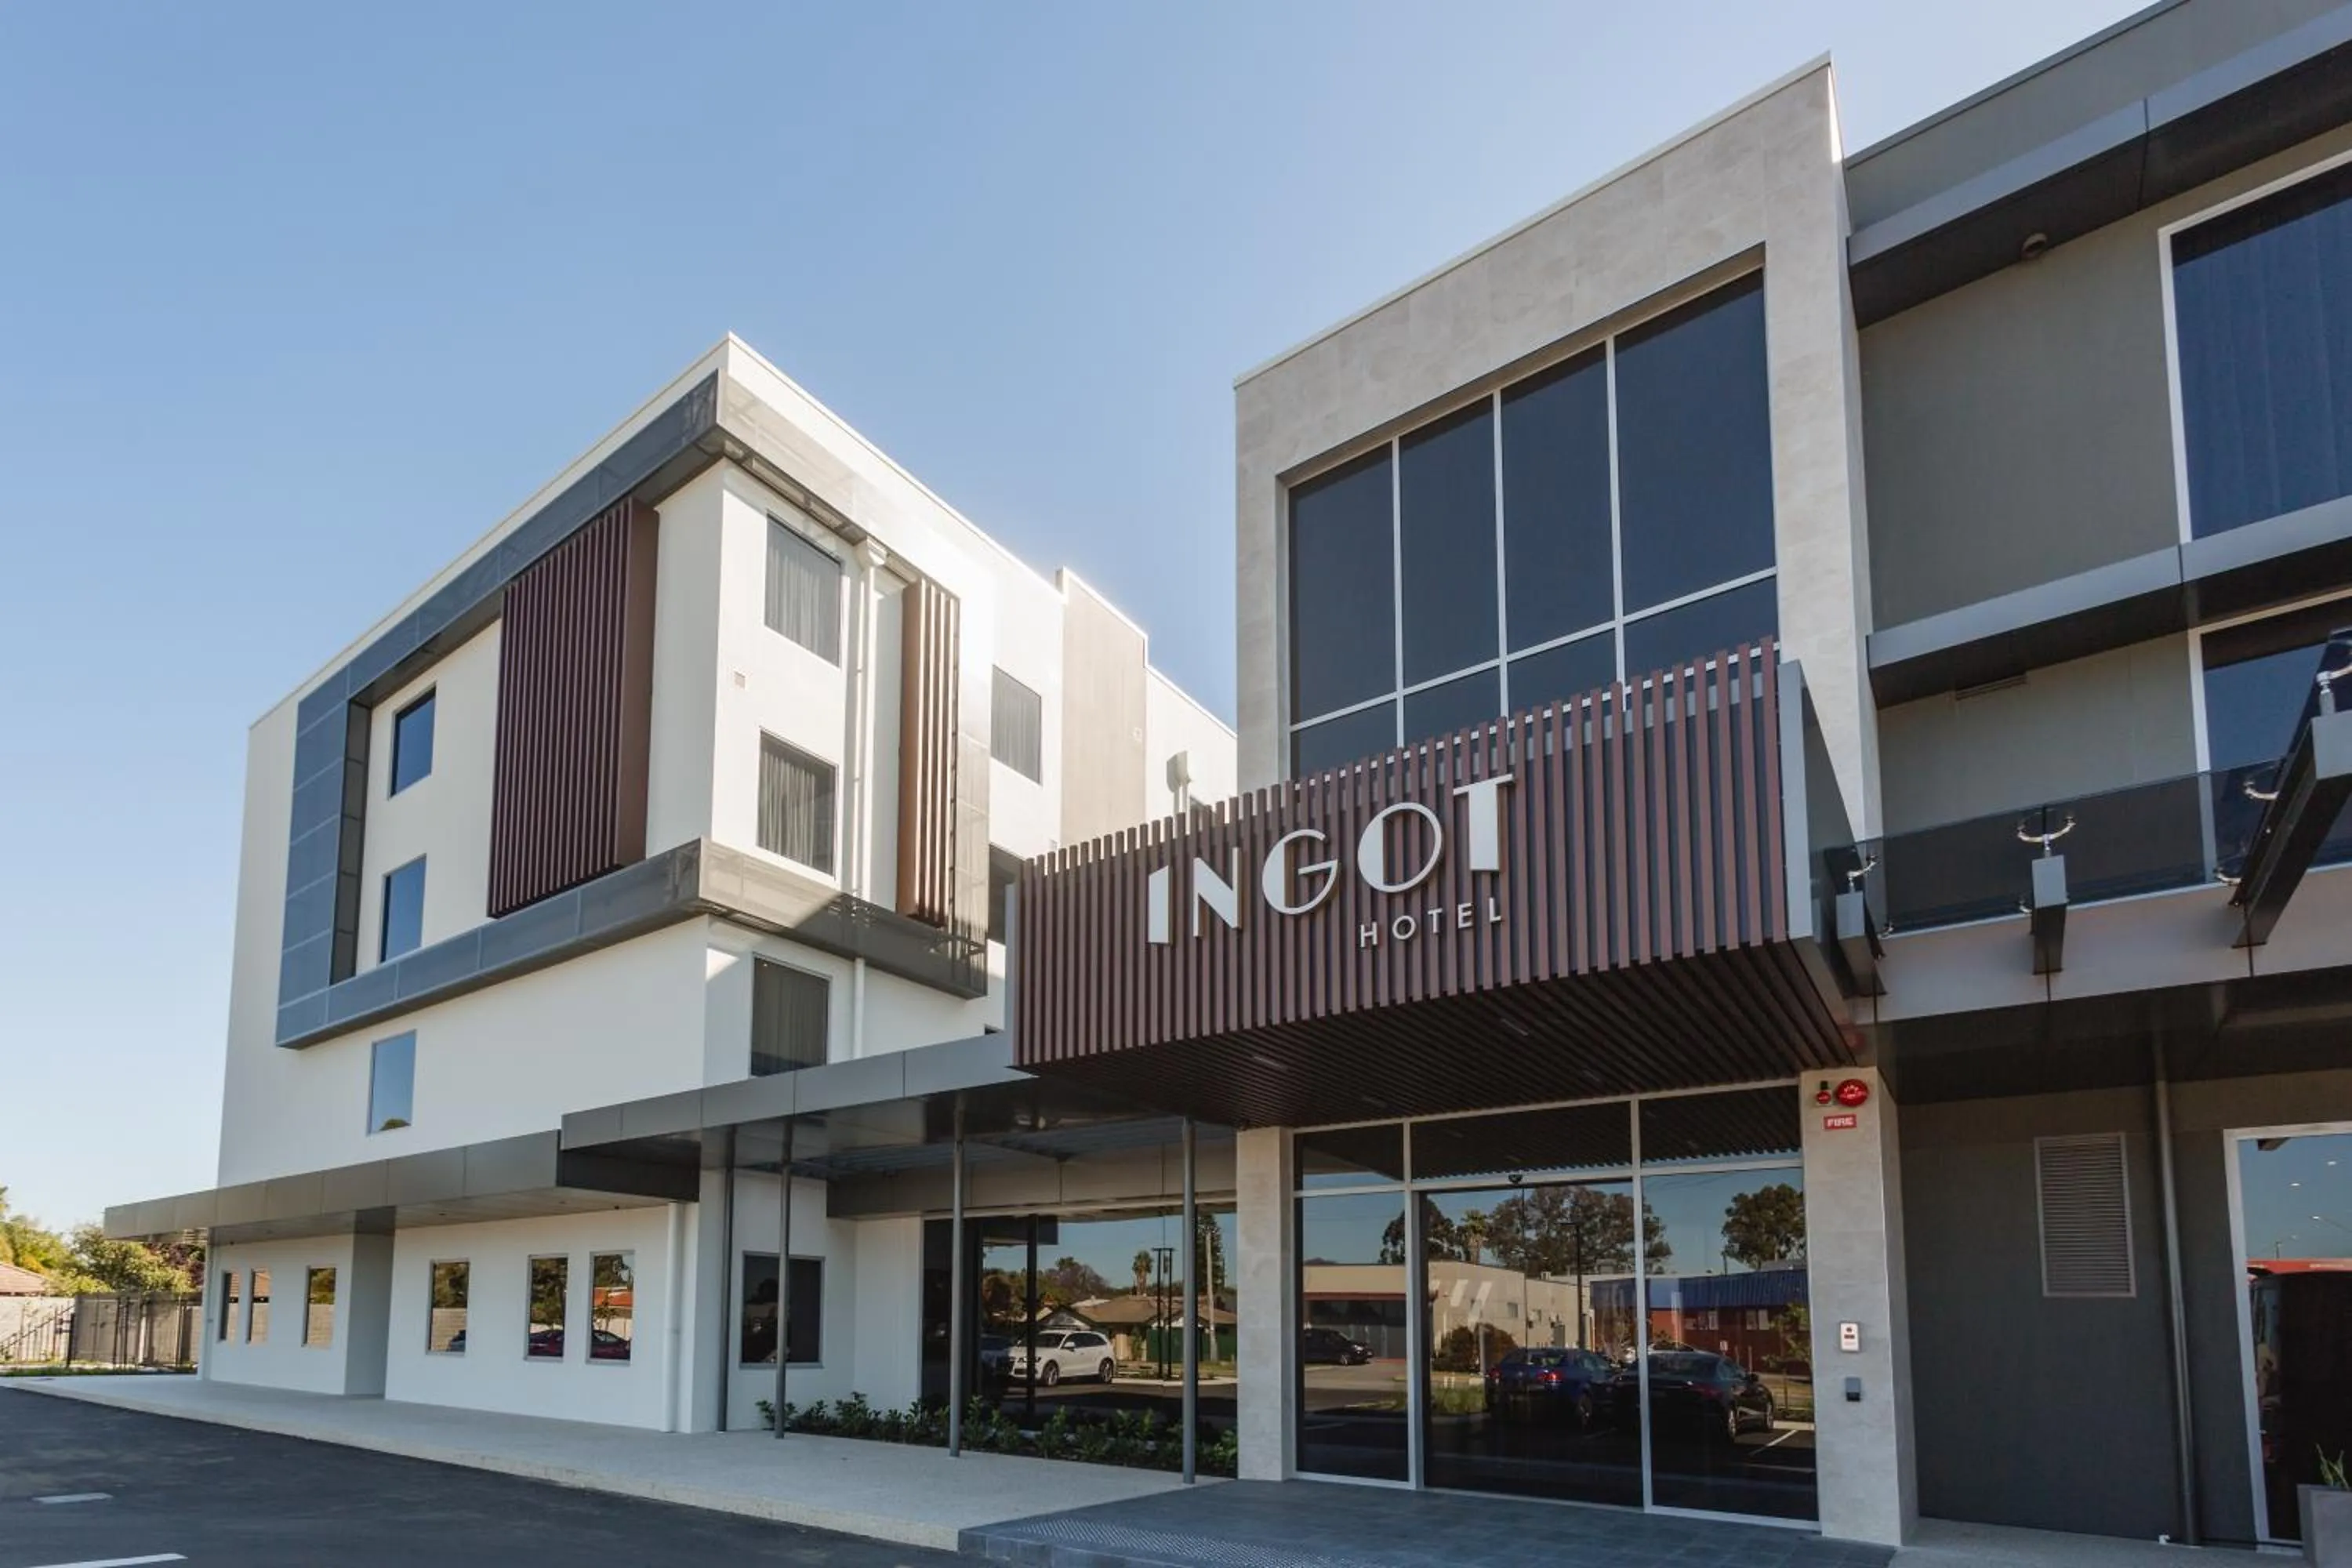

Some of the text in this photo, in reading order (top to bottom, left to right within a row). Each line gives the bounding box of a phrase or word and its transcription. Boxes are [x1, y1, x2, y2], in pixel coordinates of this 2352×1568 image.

[1148, 773, 1514, 944] INGOT
[1359, 896, 1502, 949] HOTEL
[1827, 1116, 1854, 1127] FIRE
